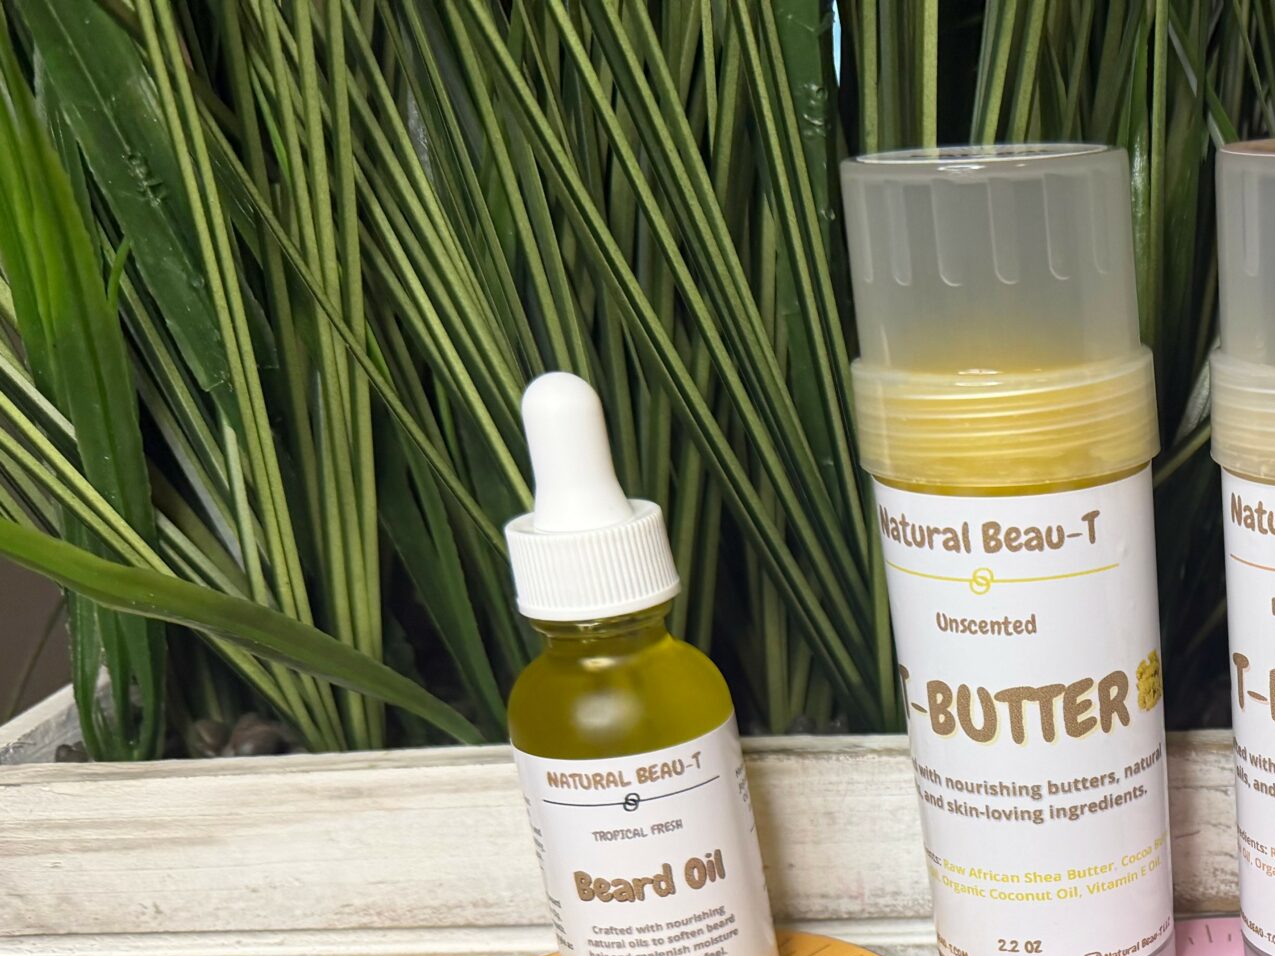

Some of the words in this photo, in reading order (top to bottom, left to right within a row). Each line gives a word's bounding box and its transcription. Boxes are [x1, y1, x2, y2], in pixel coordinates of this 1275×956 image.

[879, 504, 971, 554] Natural
[981, 509, 1100, 554] Beau-T
[935, 611, 1038, 636] Unscented
[546, 768, 632, 792] NATURAL
[635, 751, 702, 784] BEAU-T
[919, 765, 942, 787] with
[945, 777, 1042, 800] nourishing
[1047, 770, 1120, 796] butters,
[1124, 743, 1163, 779] natural
[923, 790, 944, 810] and
[947, 798, 1044, 825] skin-loving
[1049, 784, 1148, 822] ingredients.
[591, 825, 649, 843] TROPICAL
[650, 818, 683, 836] FRESH
[573, 862, 677, 903] Beard
[684, 848, 726, 890] Oil
[942, 875, 985, 898] Organic
[989, 887, 1052, 902] Coconut
[1056, 887, 1082, 900] Oil,
[1086, 870, 1138, 896] Vitamin
[943, 858, 966, 875] Raw
[969, 866, 1021, 885] African
[1024, 869, 1062, 884] Shea
[587, 936, 626, 950] natural
[628, 935, 650, 948] oils
[653, 934, 665, 946] to
[667, 927, 703, 944] soften
[705, 913, 735, 934] beard
[591, 924, 633, 936] Crafted
[635, 921, 663, 934] with
[666, 904, 725, 930] nourishing
[693, 927, 739, 951] moisture
[997, 938, 1020, 953] 2.2
[1024, 939, 1043, 954] OZ
